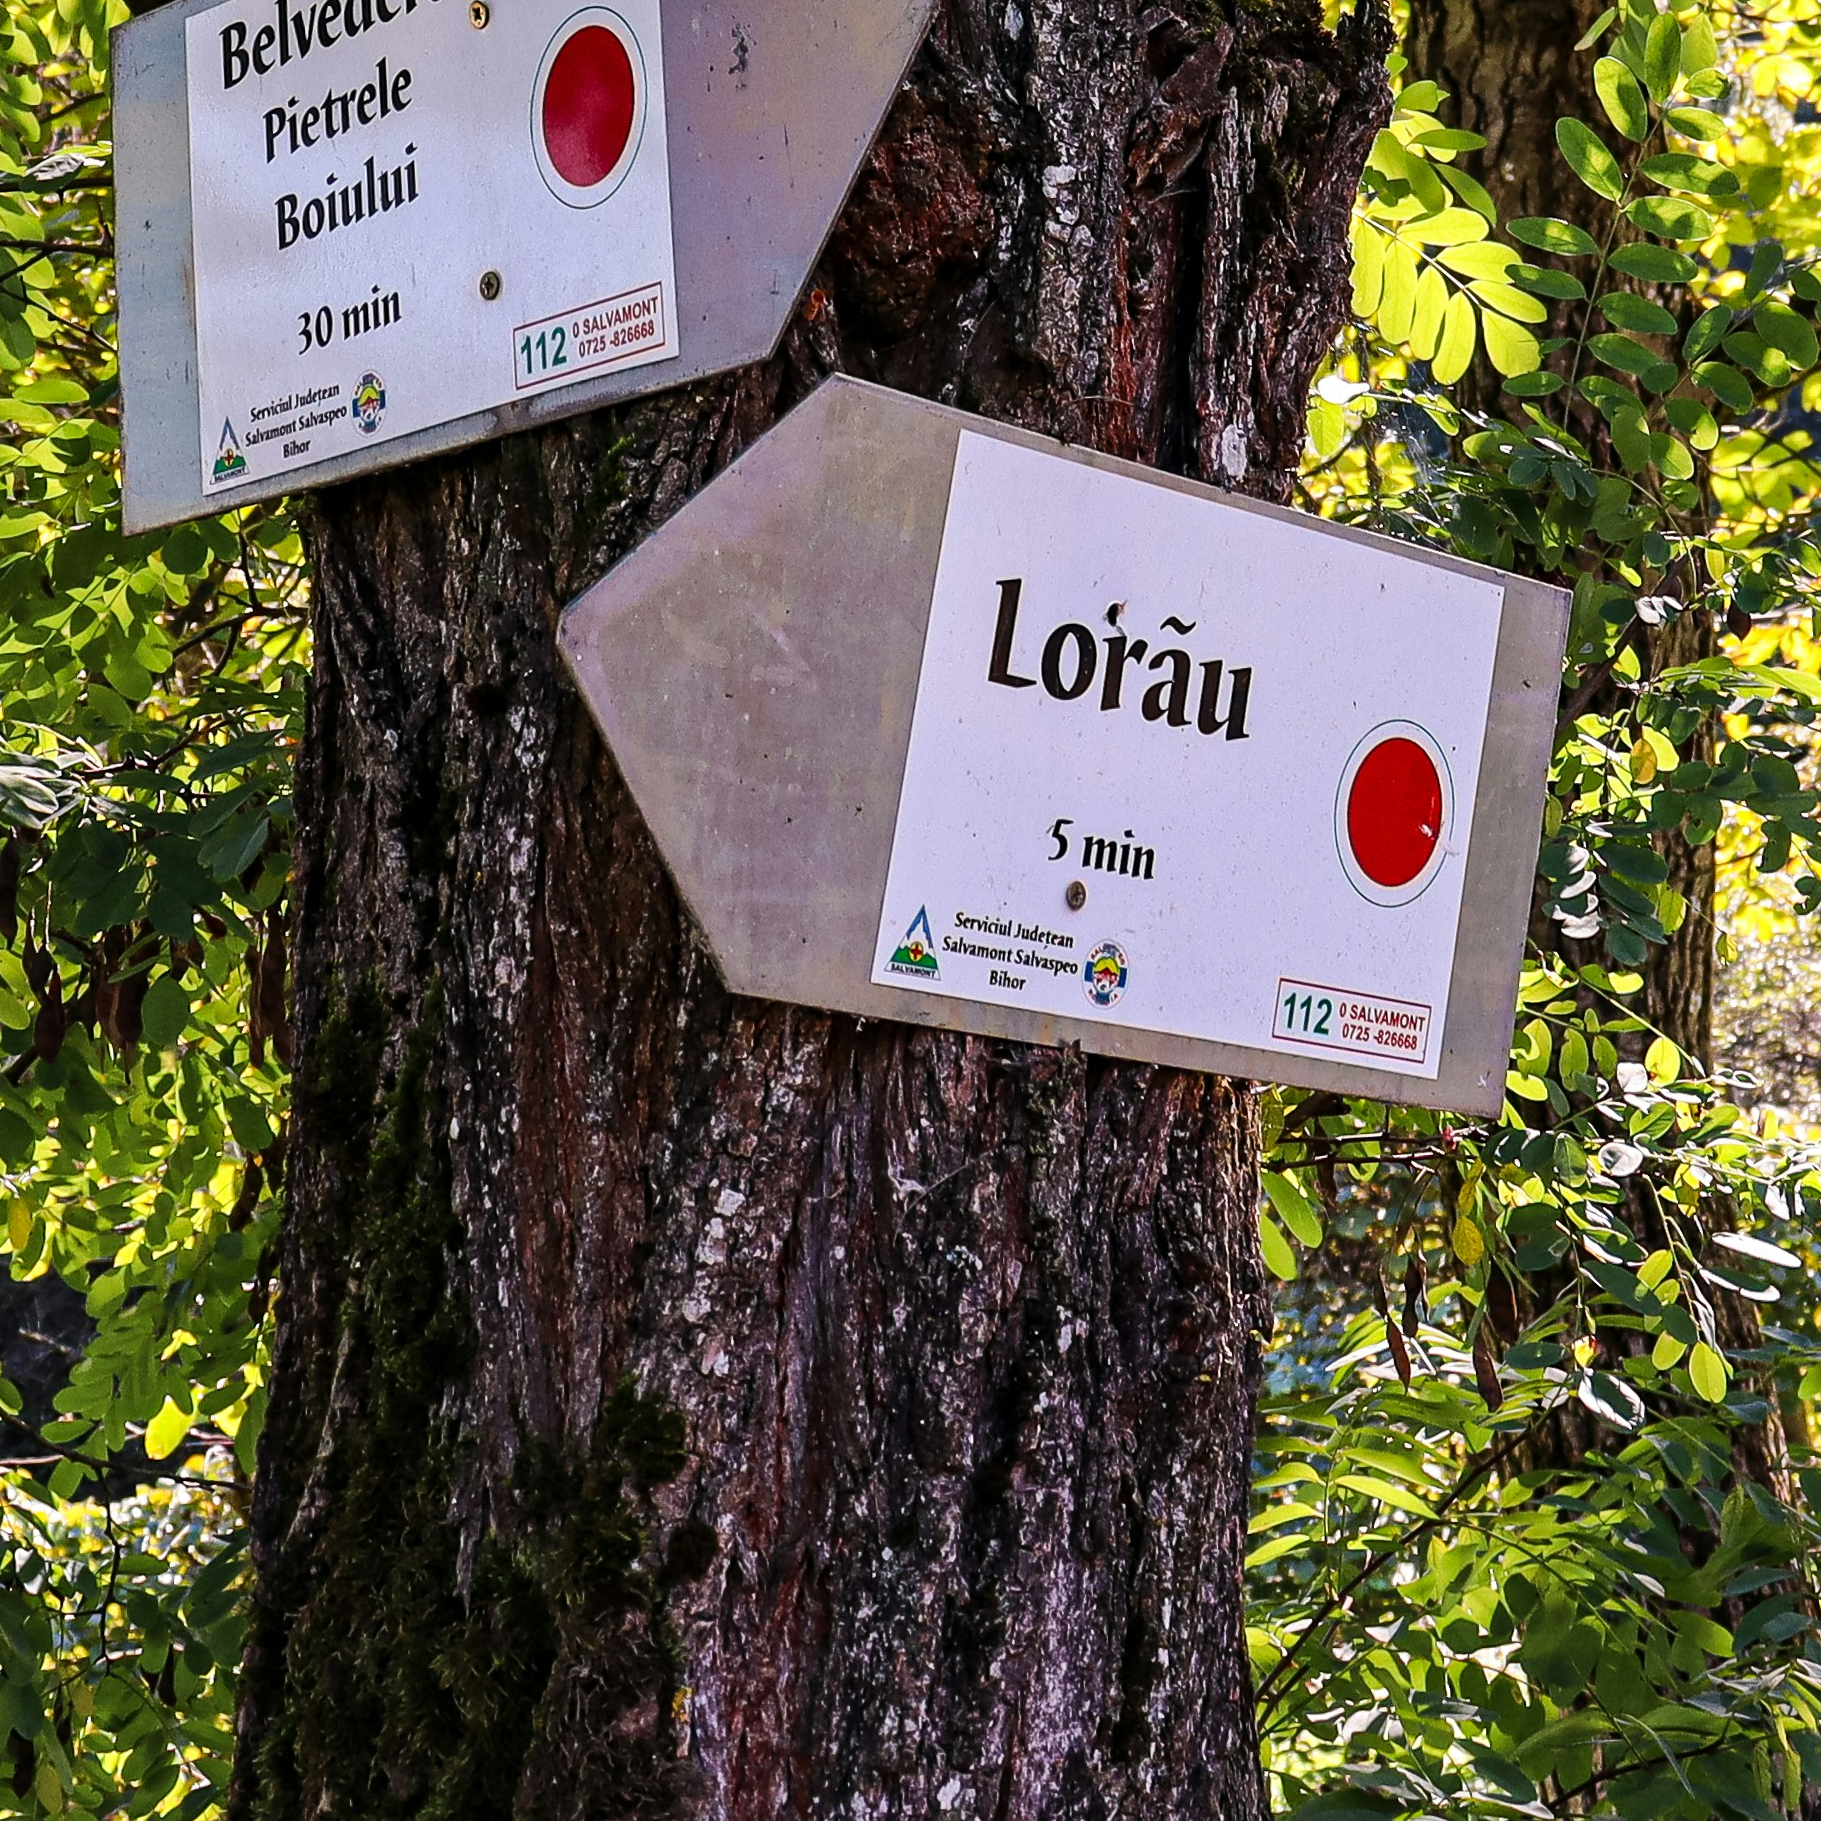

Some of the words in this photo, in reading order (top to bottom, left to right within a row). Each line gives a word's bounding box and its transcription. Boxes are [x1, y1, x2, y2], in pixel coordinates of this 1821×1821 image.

[262, 56, 412, 164] Pietrele
[274, 142, 419, 250] Boiului
[297, 305, 333, 355] 30
[341, 284, 402, 341] min
[583, 296, 658, 335] SALVAMONT
[520, 327, 567, 374] 112
[579, 335, 606, 358] 0725
[245, 420, 297, 447] Salvamont
[298, 405, 348, 432] Salvaspeo
[250, 395, 293, 422] Serviciul
[283, 440, 311, 458] Bihor
[1047, 819, 1074, 861] 5
[1082, 829, 1155, 879] min
[954, 912, 1012, 937] Serviciul
[942, 935, 1012, 963] Salvamont
[1014, 949, 1078, 977] Salvaspeo
[989, 970, 1026, 990] Bihor
[1284, 992, 1332, 1035] 112
[1342, 1023, 1370, 1042] 0725
[1349, 1004, 1426, 1032] SALVAMONT
